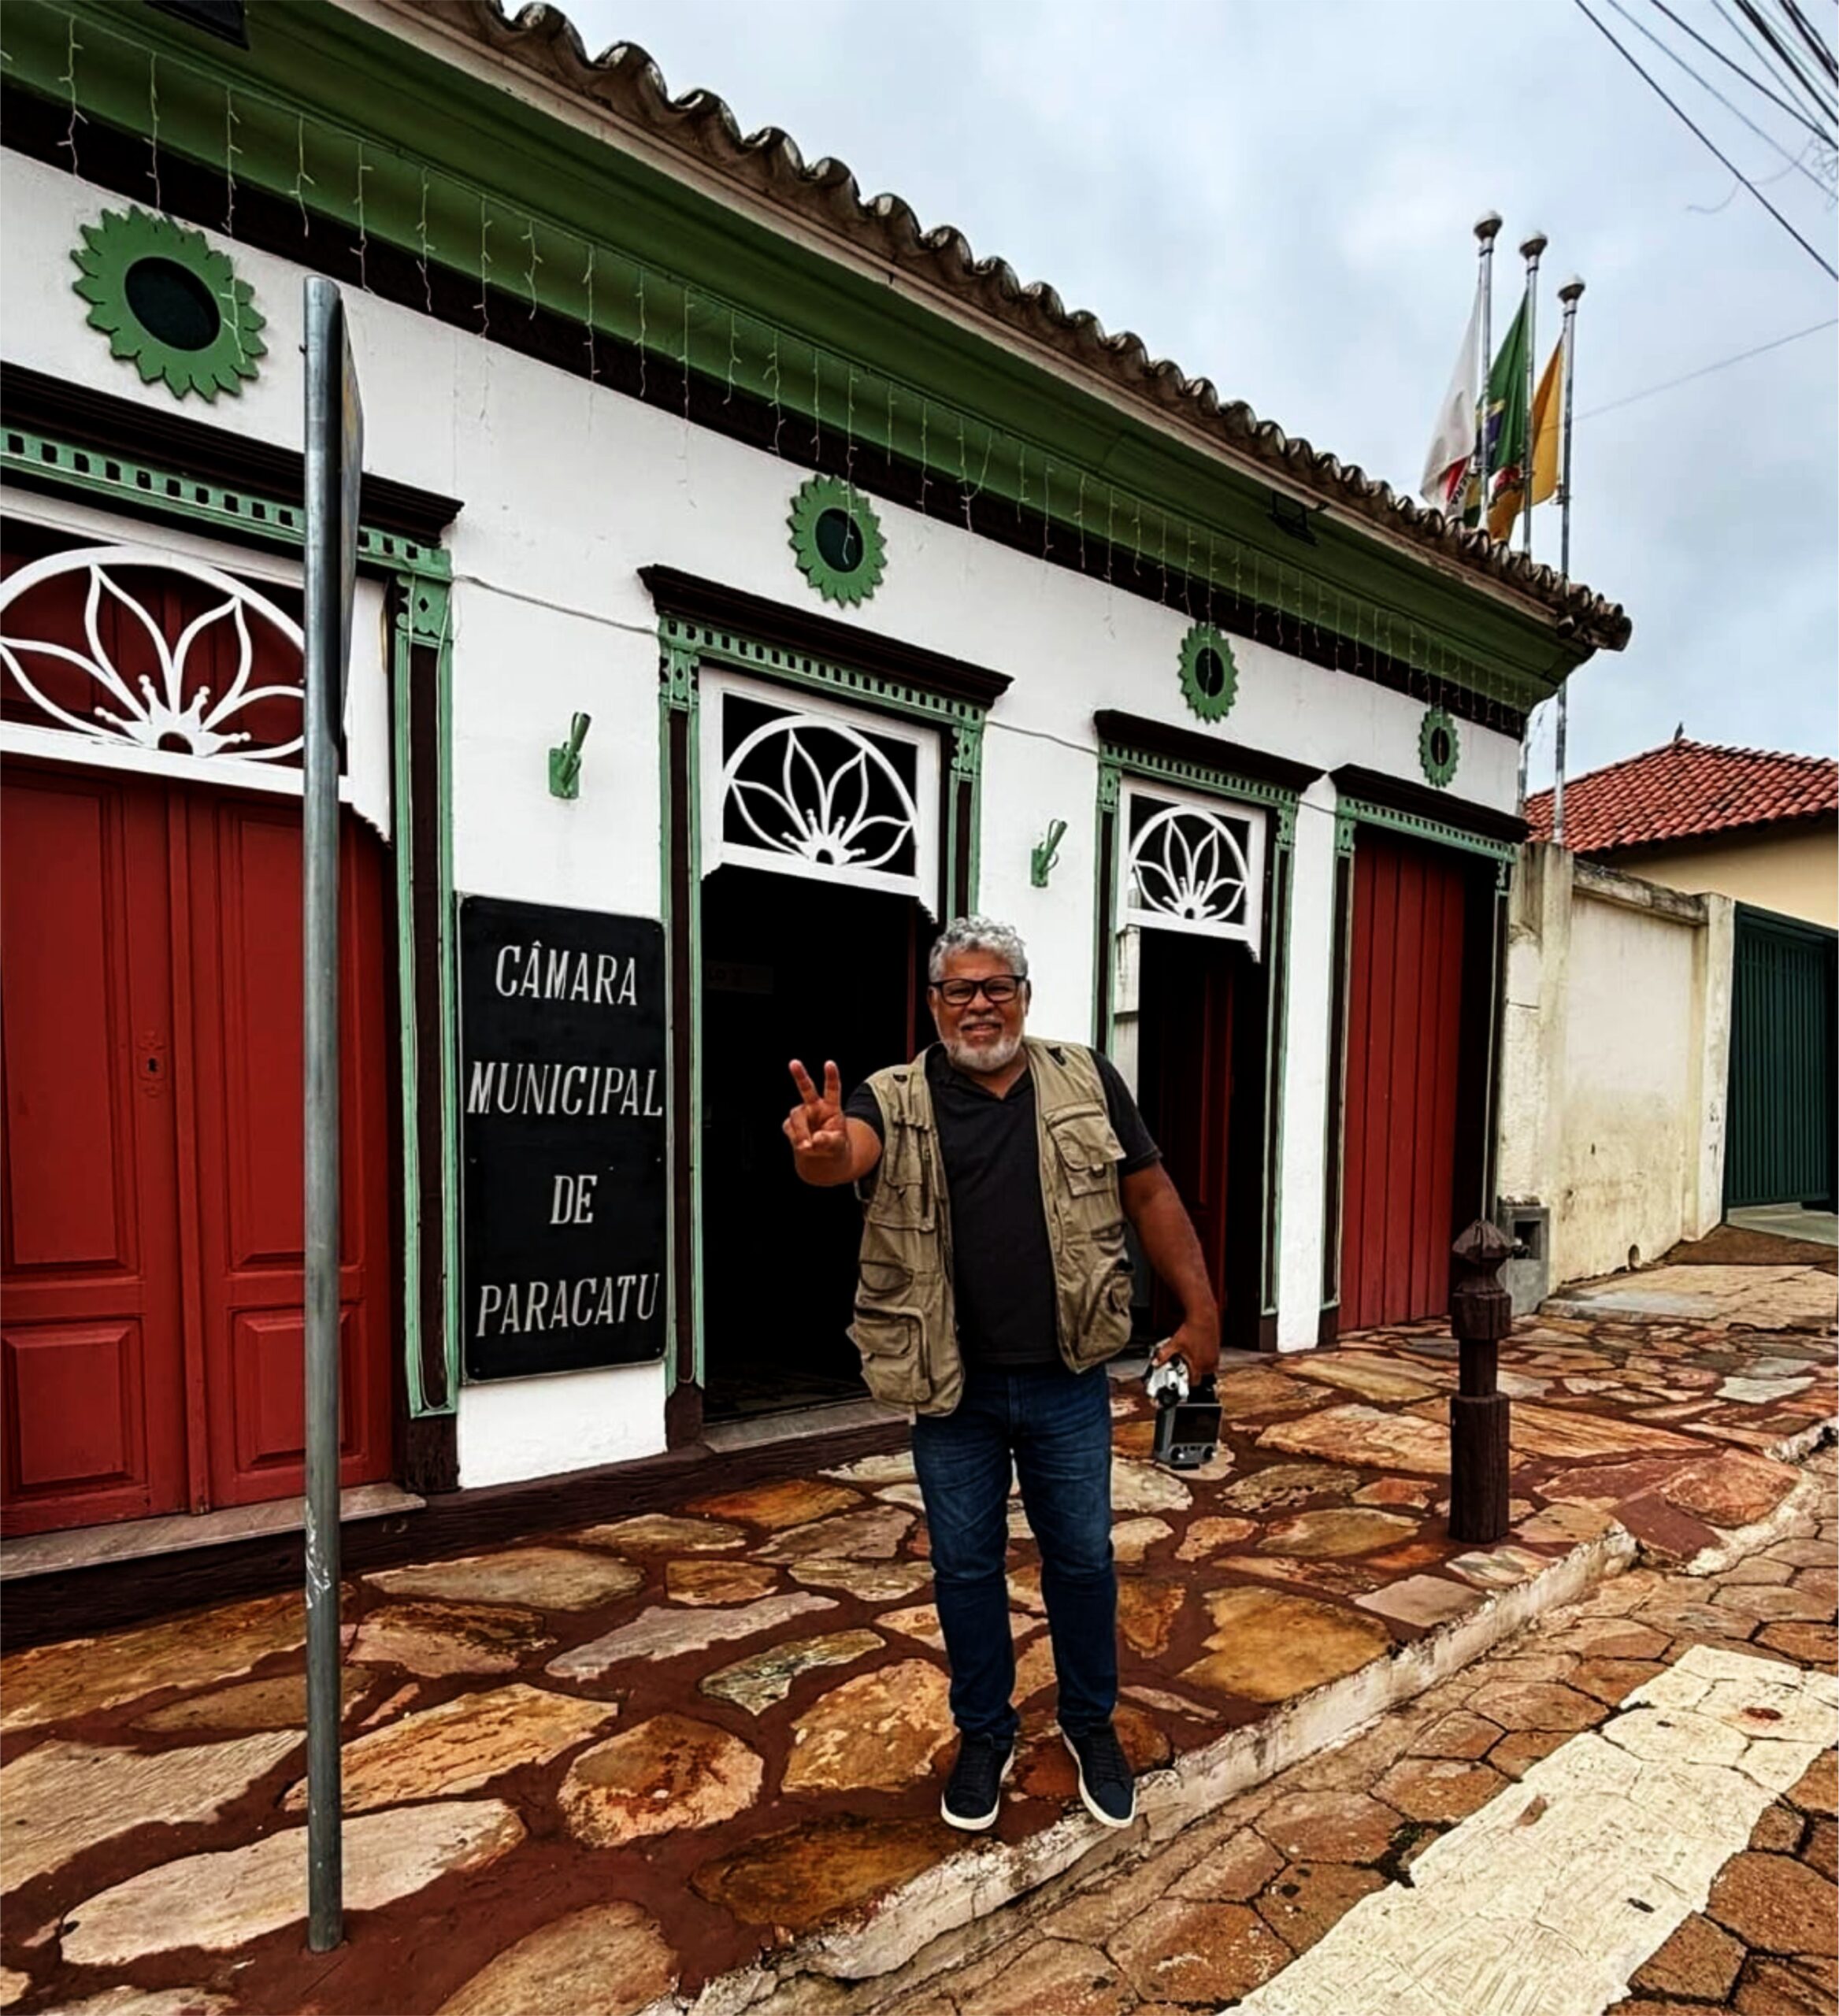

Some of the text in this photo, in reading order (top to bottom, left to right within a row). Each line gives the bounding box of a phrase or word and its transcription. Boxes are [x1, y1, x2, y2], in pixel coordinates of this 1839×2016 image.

[495, 940, 637, 1006] CÂMARA
[466, 1061, 663, 1117] MUNICIPAL
[550, 1174, 598, 1225] DE
[476, 1273, 660, 1336] PARACATU
